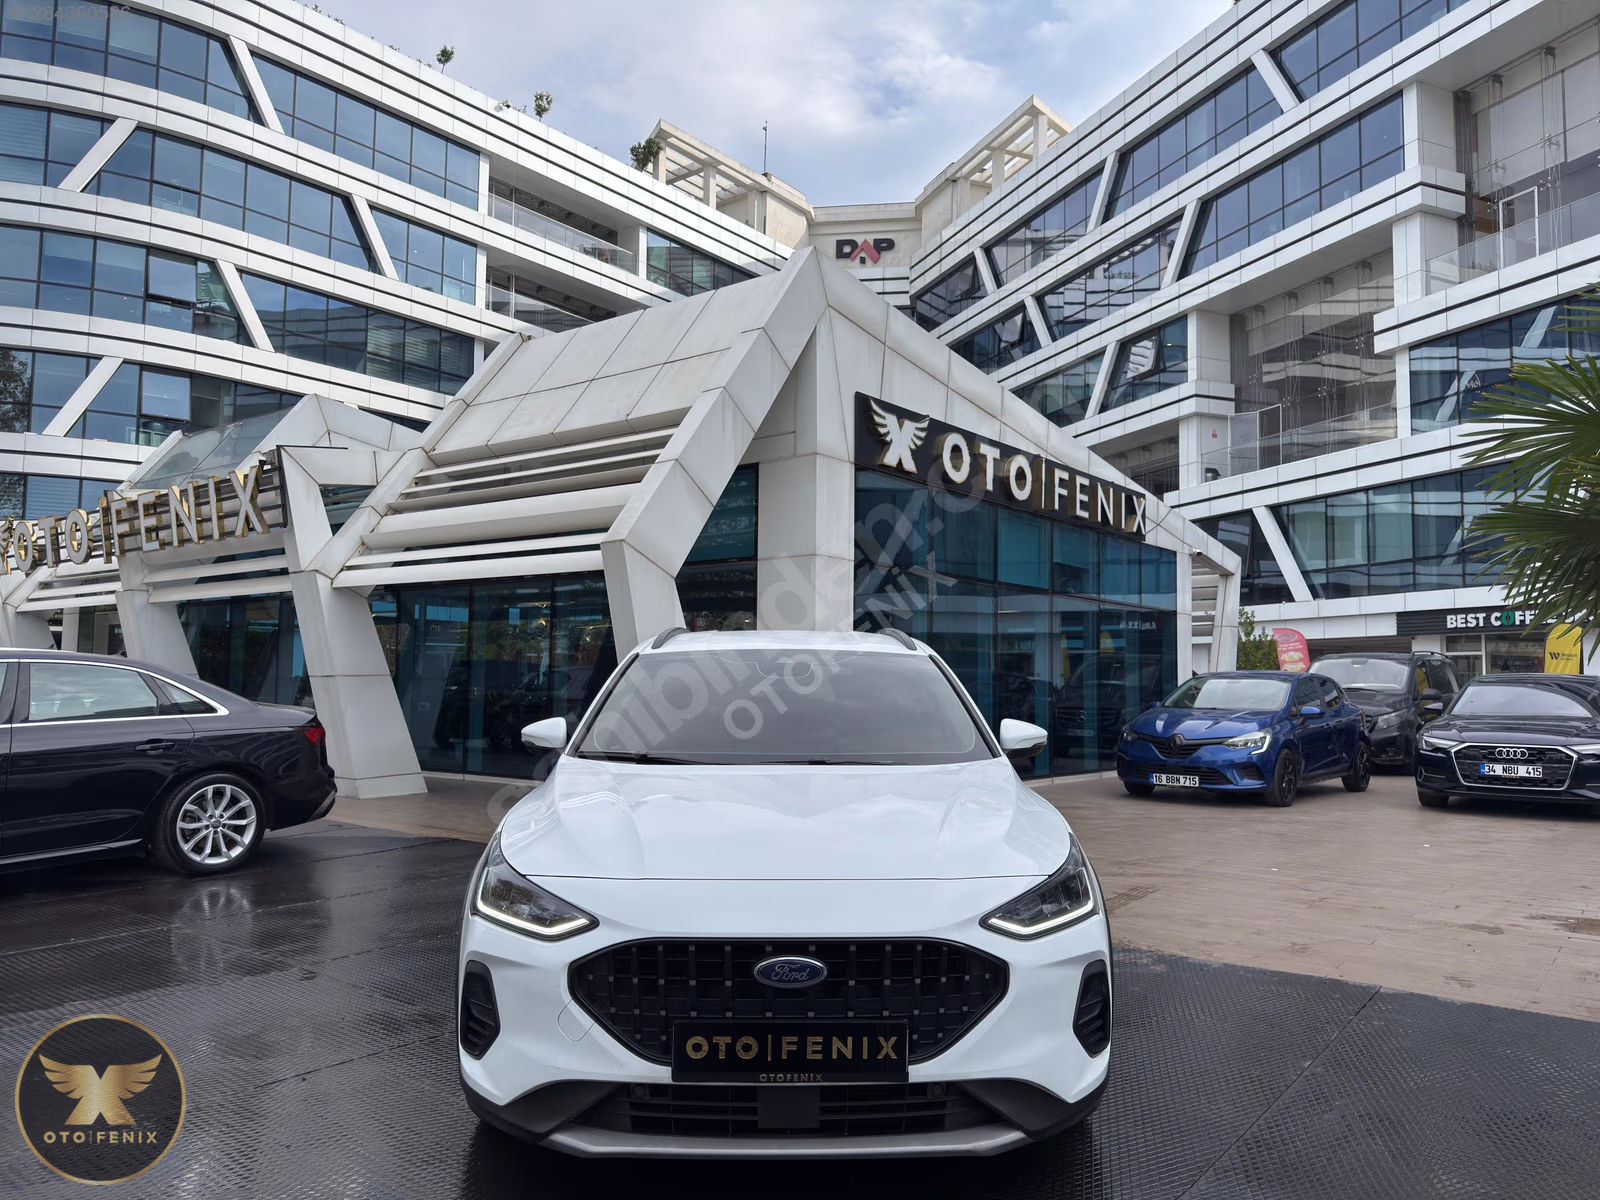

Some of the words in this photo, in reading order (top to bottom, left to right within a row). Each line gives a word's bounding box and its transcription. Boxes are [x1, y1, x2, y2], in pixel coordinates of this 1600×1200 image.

[836, 237, 895, 264] DAP
[1446, 612, 1486, 629] BEST
[1485, 765, 1496, 774] 34
[1502, 765, 1519, 775] NBU
[1525, 767, 1541, 776] 415
[1154, 774, 1163, 783] 16
[1166, 775, 1181, 784] BBN
[1182, 776, 1197, 786] 715
[771, 963, 810, 982] Ford
[759, 1073, 823, 1082] OTOFENIX
